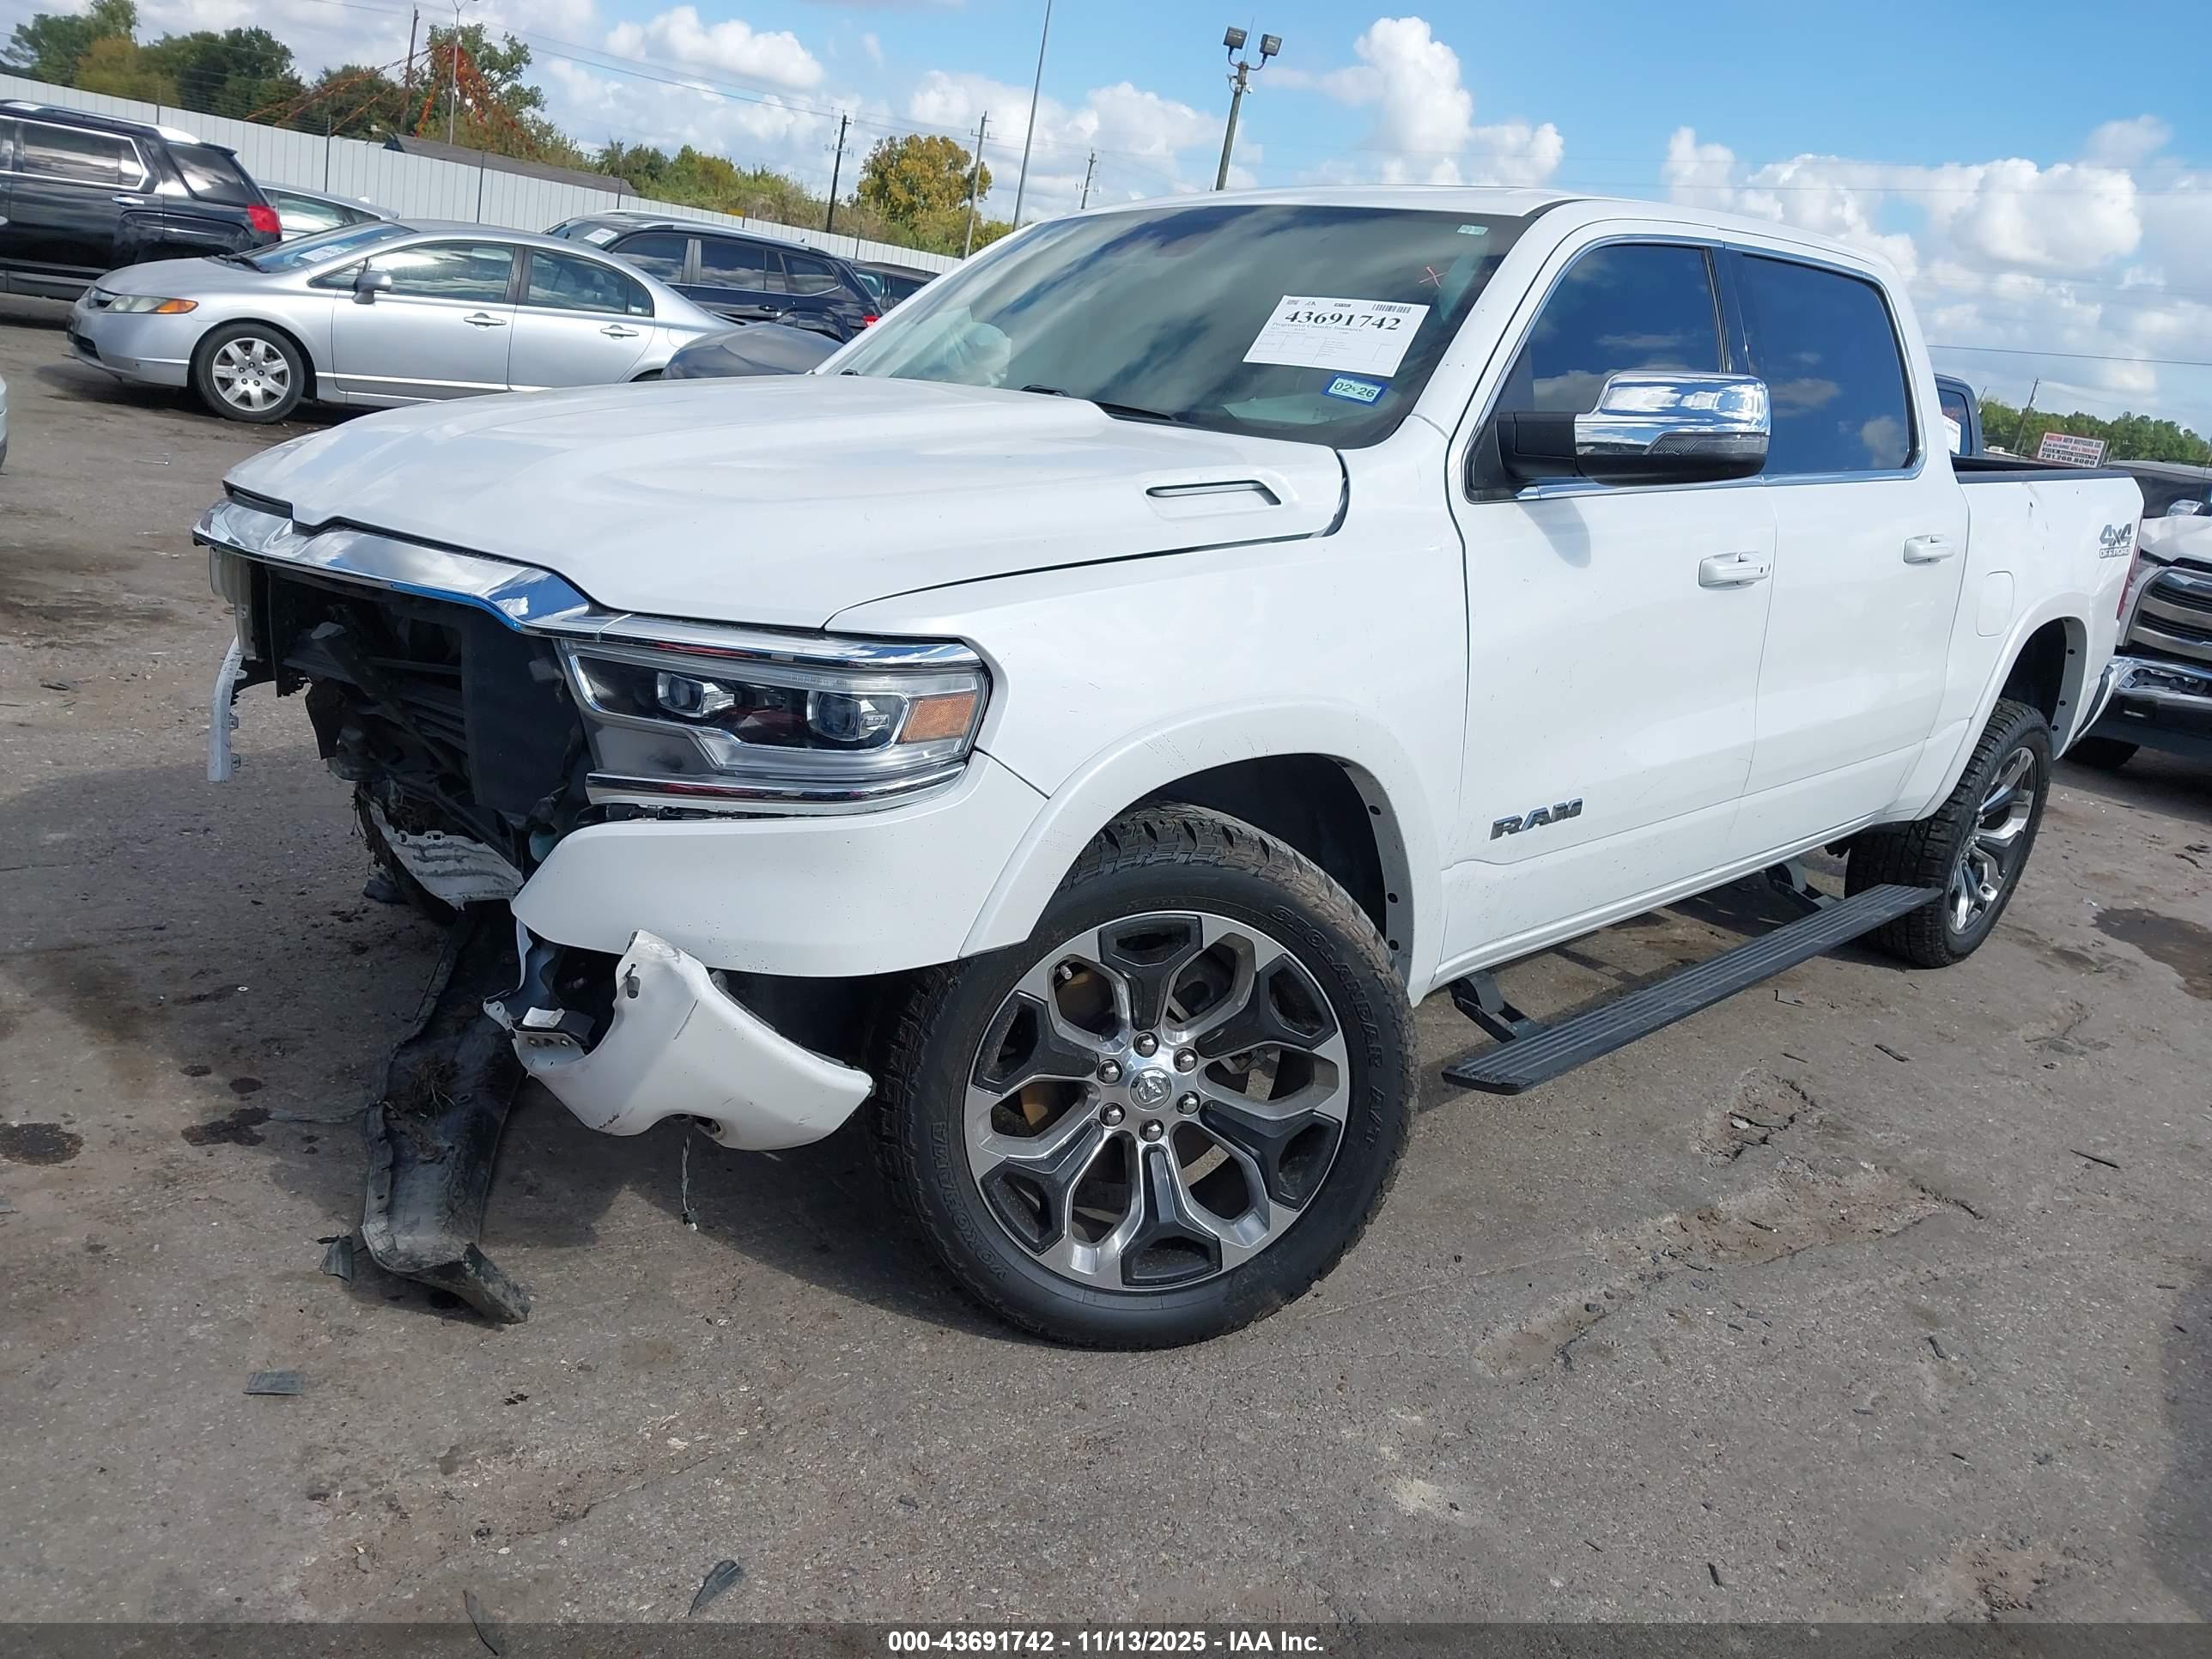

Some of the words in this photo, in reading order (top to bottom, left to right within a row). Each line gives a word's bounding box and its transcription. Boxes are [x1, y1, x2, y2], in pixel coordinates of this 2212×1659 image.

[1285, 310, 1401, 331] 43691742
[1490, 798, 1583, 841] RAM
[932, 1121, 1009, 1279] YOKOHAMA
